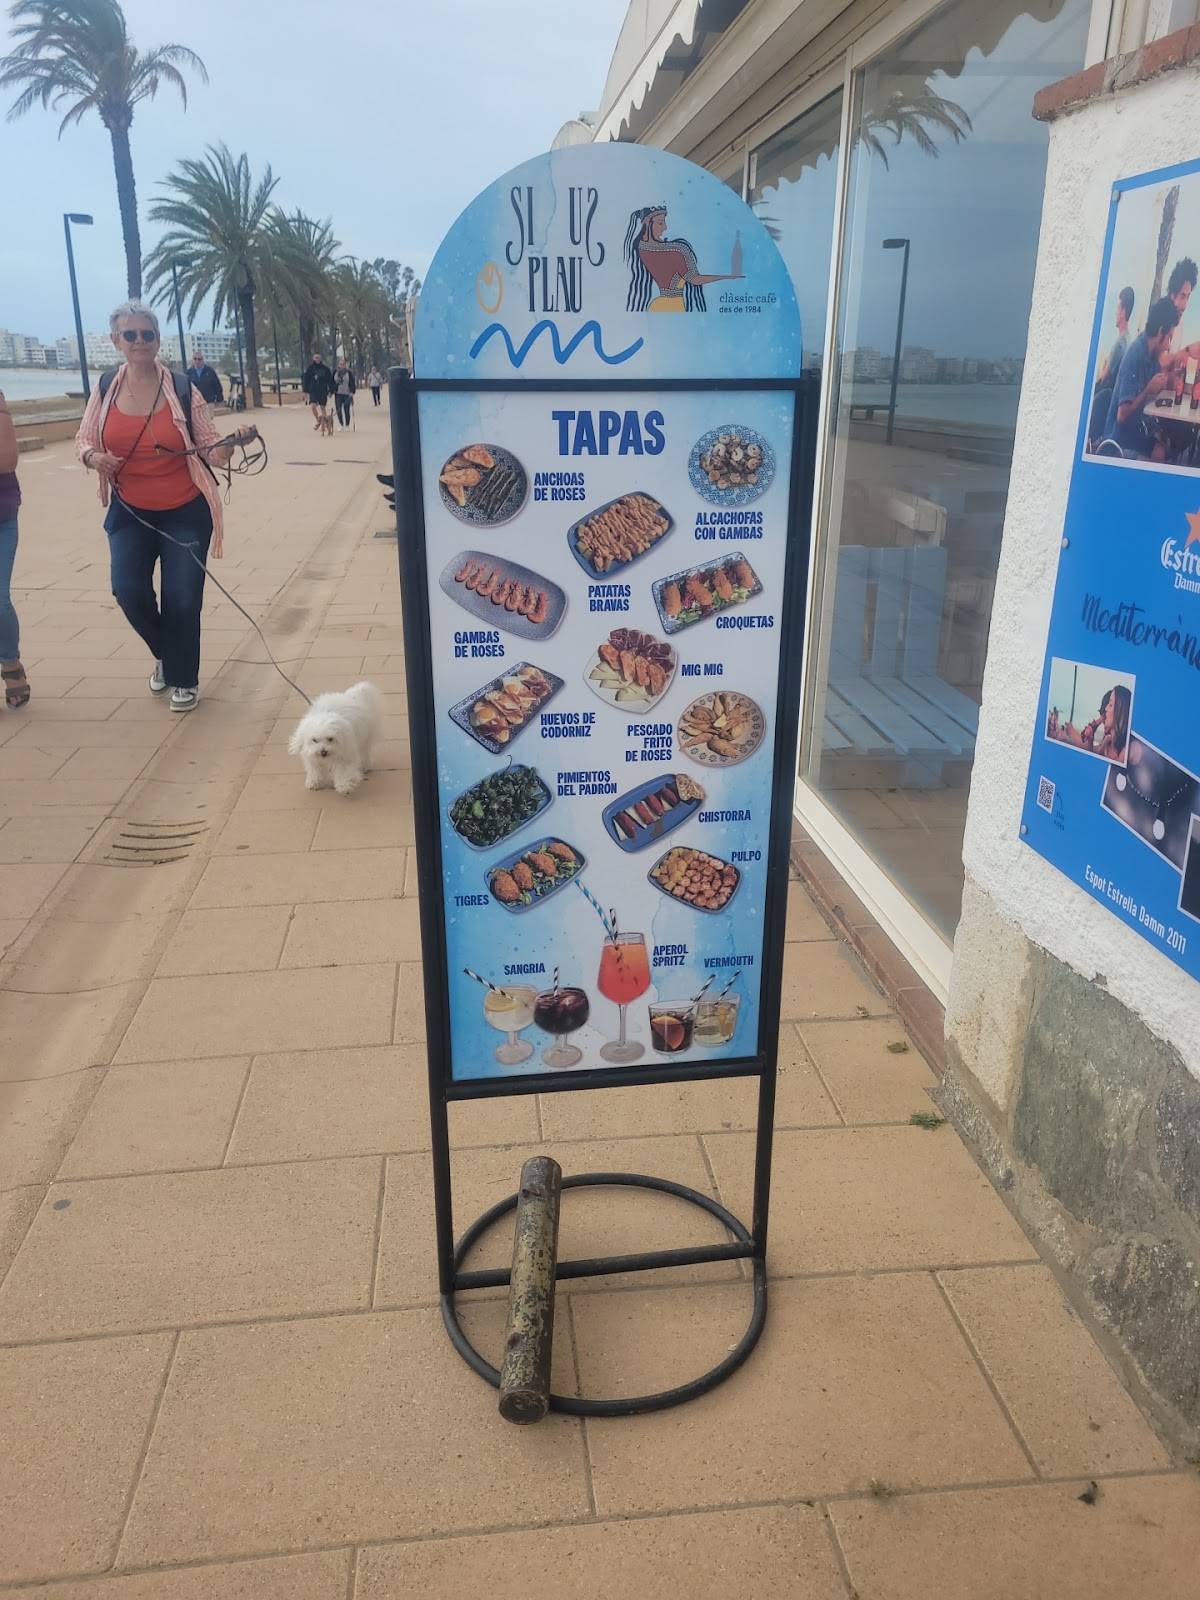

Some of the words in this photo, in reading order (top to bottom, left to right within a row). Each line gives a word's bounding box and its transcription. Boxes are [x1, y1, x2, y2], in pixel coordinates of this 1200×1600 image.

[505, 186, 535, 266] SI
[528, 256, 583, 314] PLAU
[551, 410, 666, 456] TAPAS
[534, 472, 585, 486] ANCHOAS
[534, 487, 548, 501] DE
[551, 487, 586, 501] ROSES
[696, 511, 763, 526] ALCACHOFAS
[694, 527, 716, 540] CON
[718, 526, 764, 540] GAMBAS
[588, 585, 631, 598] PATATAS
[589, 599, 630, 612] BRAVAS
[715, 615, 774, 630] CROQUETAS
[454, 631, 500, 644] GAMBAS
[454, 645, 469, 658] DE
[471, 644, 505, 658] ROSES
[681, 663, 701, 676] MIG
[703, 663, 724, 676] MIG
[540, 713, 579, 726] HUEVOS
[582, 712, 596, 725] DE
[540, 725, 592, 739] CODORNIZ
[627, 723, 673, 737] PESCADO
[643, 737, 673, 749] FRITO
[625, 750, 638, 762] DE
[640, 749, 672, 762] ROSES
[557, 770, 611, 784] PIMIENTOS
[557, 784, 576, 796] DEL
[698, 809, 751, 823] CHISTORRA
[731, 850, 761, 862] PULPO
[454, 895, 490, 907] TIGRES
[1085, 864, 1107, 893] Espot
[1107, 880, 1138, 918] Estrella
[1138, 906, 1165, 938] Damm
[1166, 927, 1187, 955] 2011
[653, 944, 689, 957] APEROL
[652, 955, 685, 968] SPRITZ
[704, 955, 754, 969] VERMOUTH
[504, 963, 546, 976] SANGRIA
